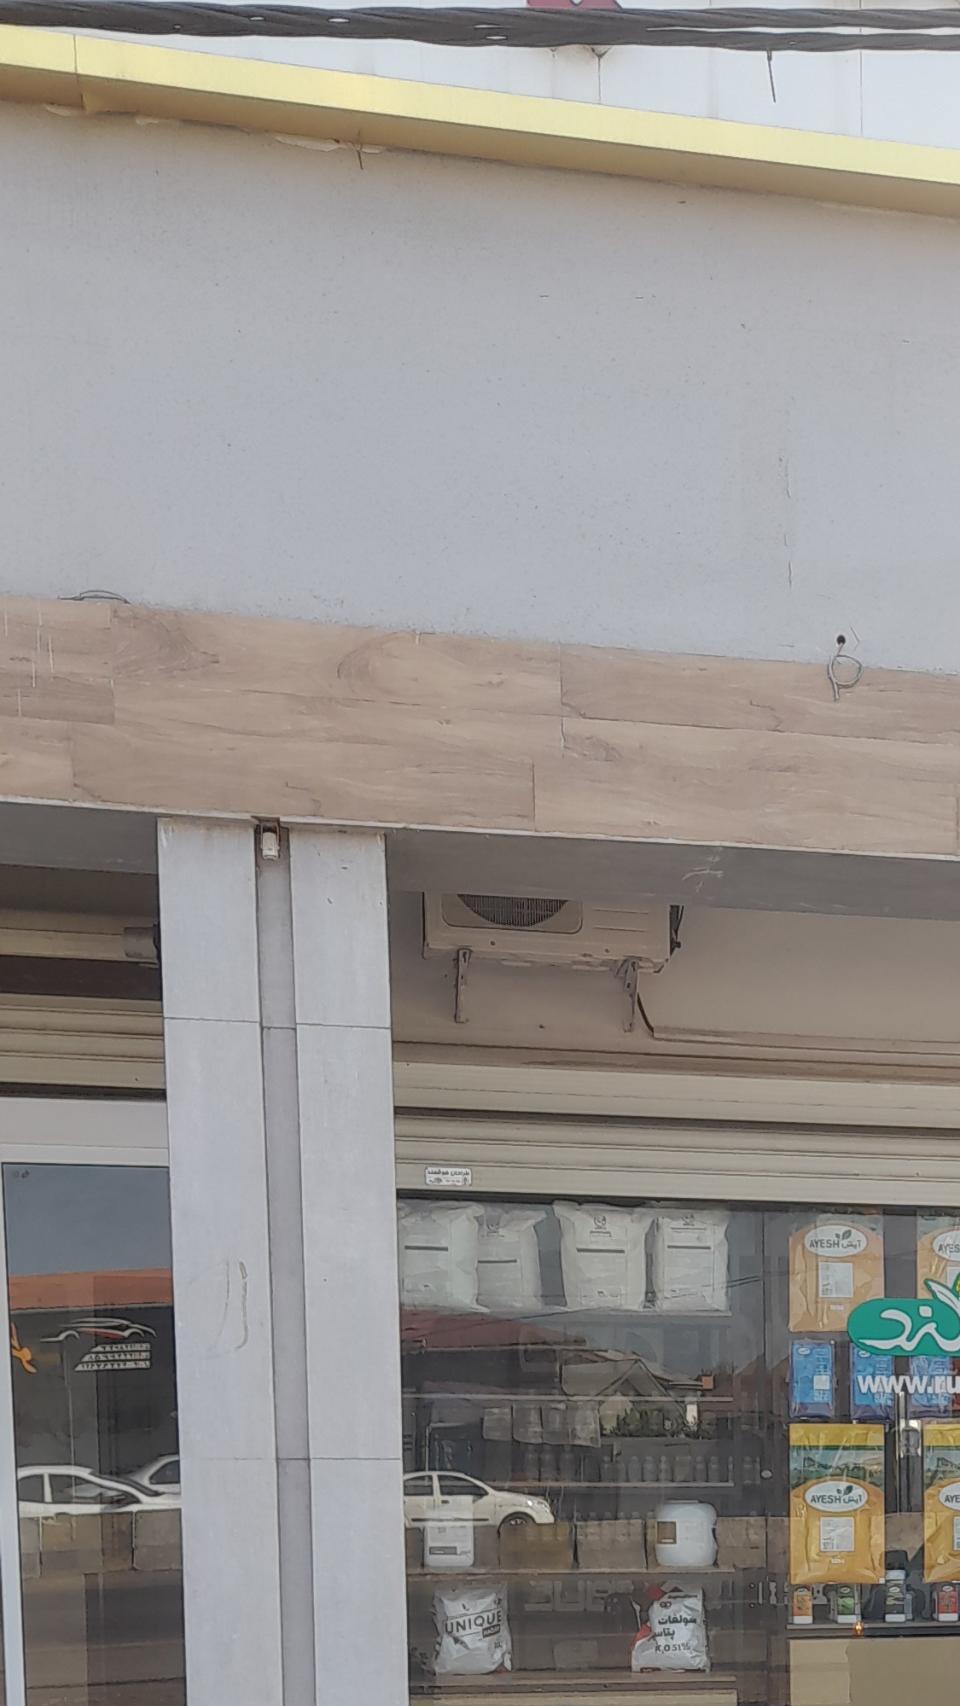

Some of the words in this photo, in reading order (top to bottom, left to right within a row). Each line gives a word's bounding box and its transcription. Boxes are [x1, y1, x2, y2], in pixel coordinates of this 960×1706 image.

[809, 1239, 840, 1249] AYESH
[810, 1494, 842, 1504] AYESH
[445, 1610, 502, 1634] UNIQUE
